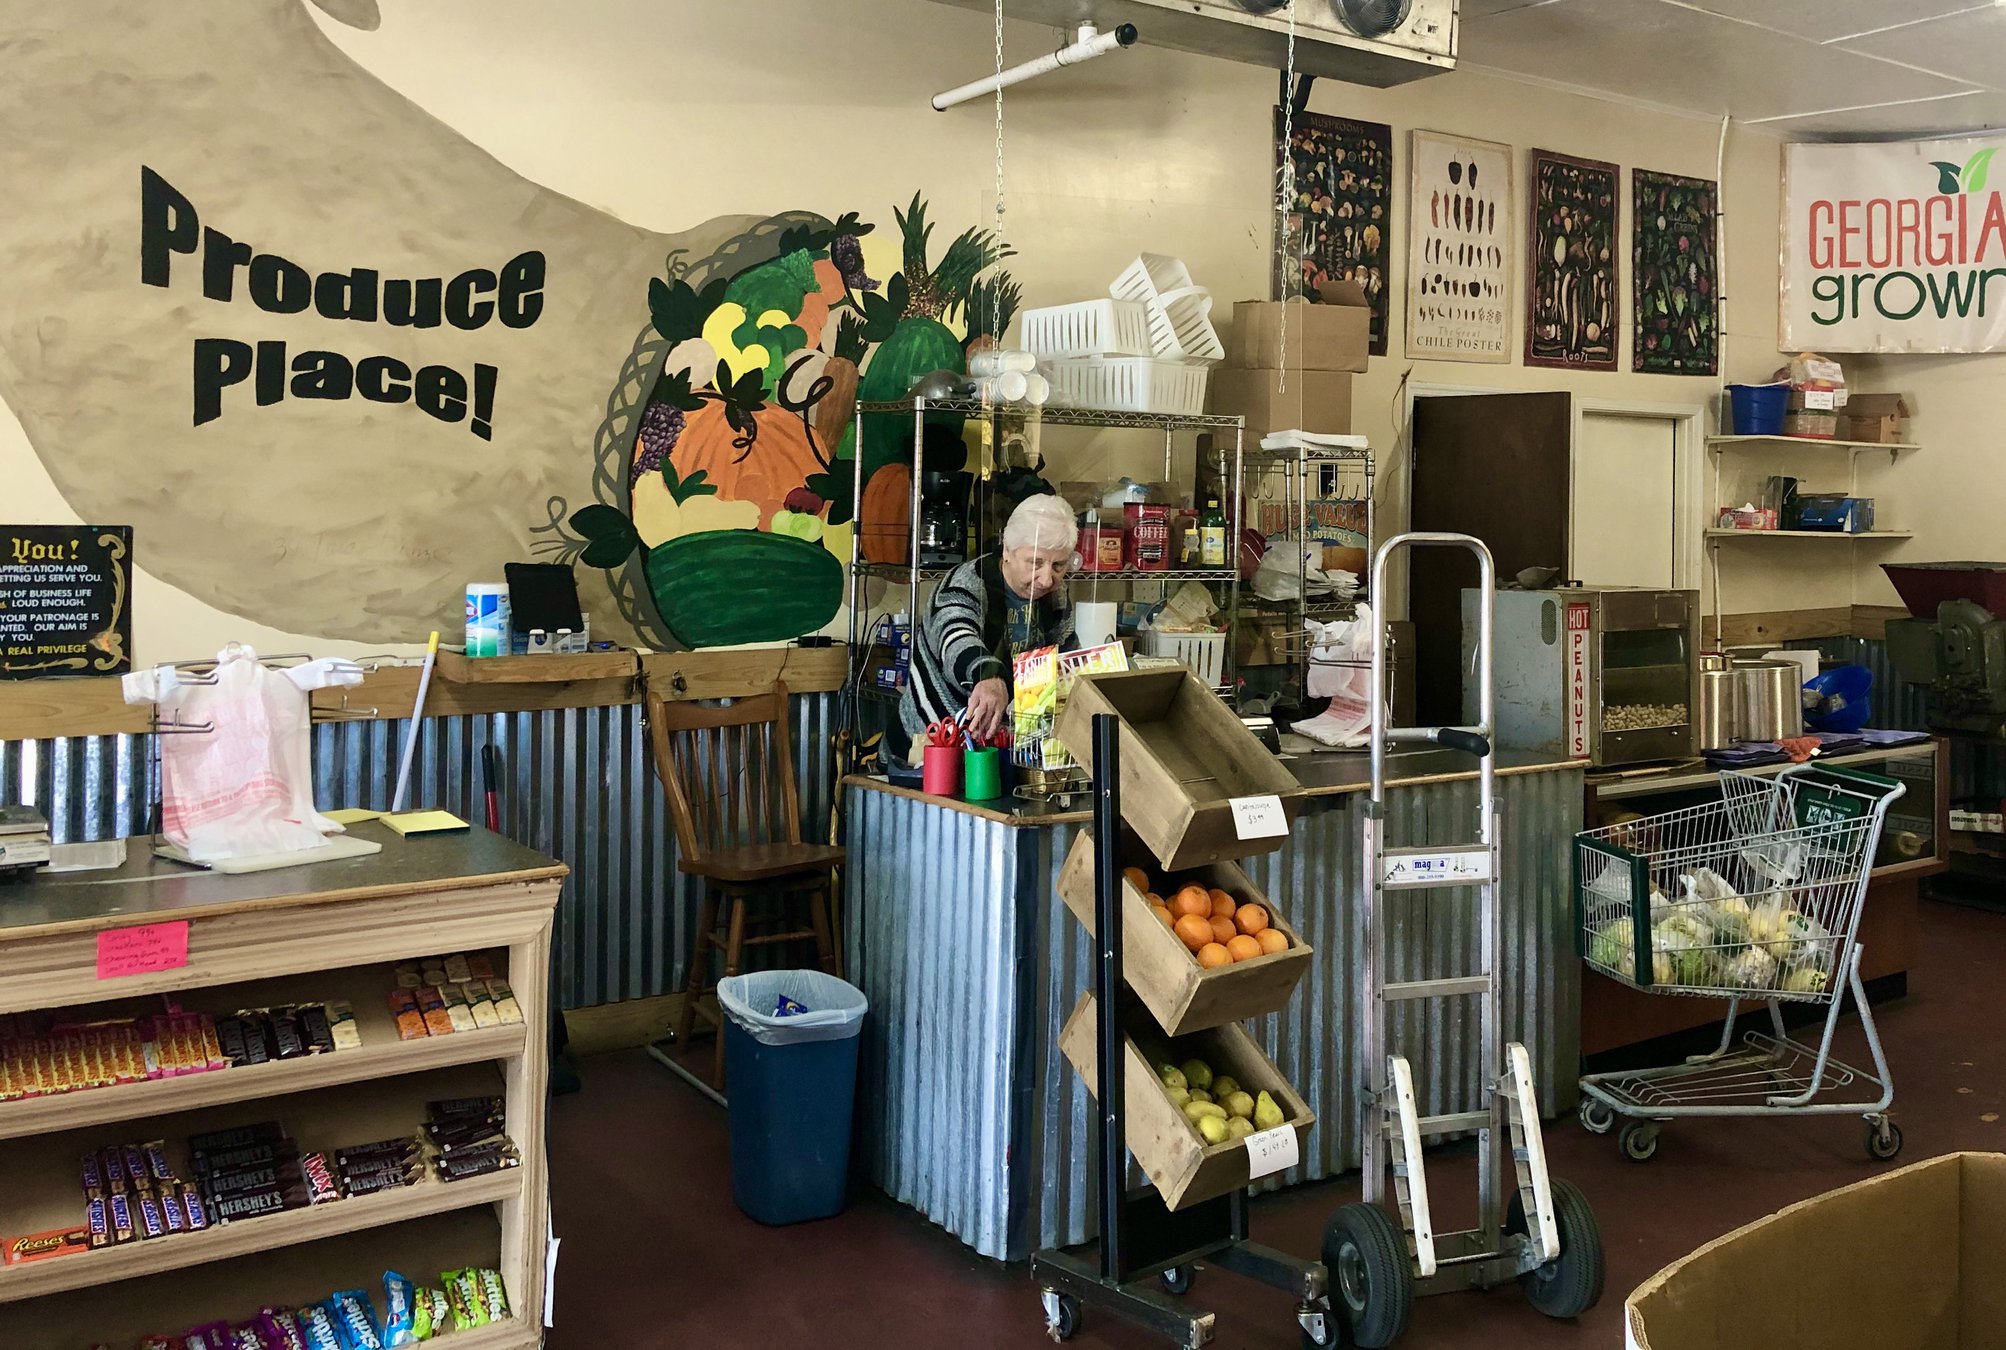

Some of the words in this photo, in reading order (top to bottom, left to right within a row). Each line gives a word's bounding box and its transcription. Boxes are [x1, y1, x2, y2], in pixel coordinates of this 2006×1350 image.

[1809, 191, 2006, 269] GEORGIA
[142, 165, 546, 330] Produce
[1811, 268, 2006, 326] grown
[1439, 327, 1453, 336] The
[1456, 328, 1480, 338] Great
[1417, 336, 1452, 348] CHILE
[1457, 339, 1502, 351] POSTER
[194, 339, 498, 441] Place!
[1134, 526, 1169, 539] COFFEE
[1312, 531, 1352, 543] POTATOES
[66, 565, 88, 573] AND
[49, 574, 76, 582] SERVE
[80, 574, 102, 582] YOU.
[75, 589, 92, 597] LIFE
[42, 599, 86, 607] ENOUGH.
[0, 614, 27, 622] YOUR
[30, 613, 89, 621] PATRONAGE
[1569, 609, 1589, 629] HOT
[34, 623, 55, 631] OUR
[58, 623, 76, 631] AIM
[80, 623, 87, 631] IS
[12, 634, 34, 642] YOU.
[8, 646, 33, 655] REAL
[37, 645, 87, 653] PRIVILEGE
[1574, 633, 1584, 752] PEANUTS
[213, 1169, 276, 1192] HERSHEY'S
[219, 1191, 283, 1216] HERSHEY'S
